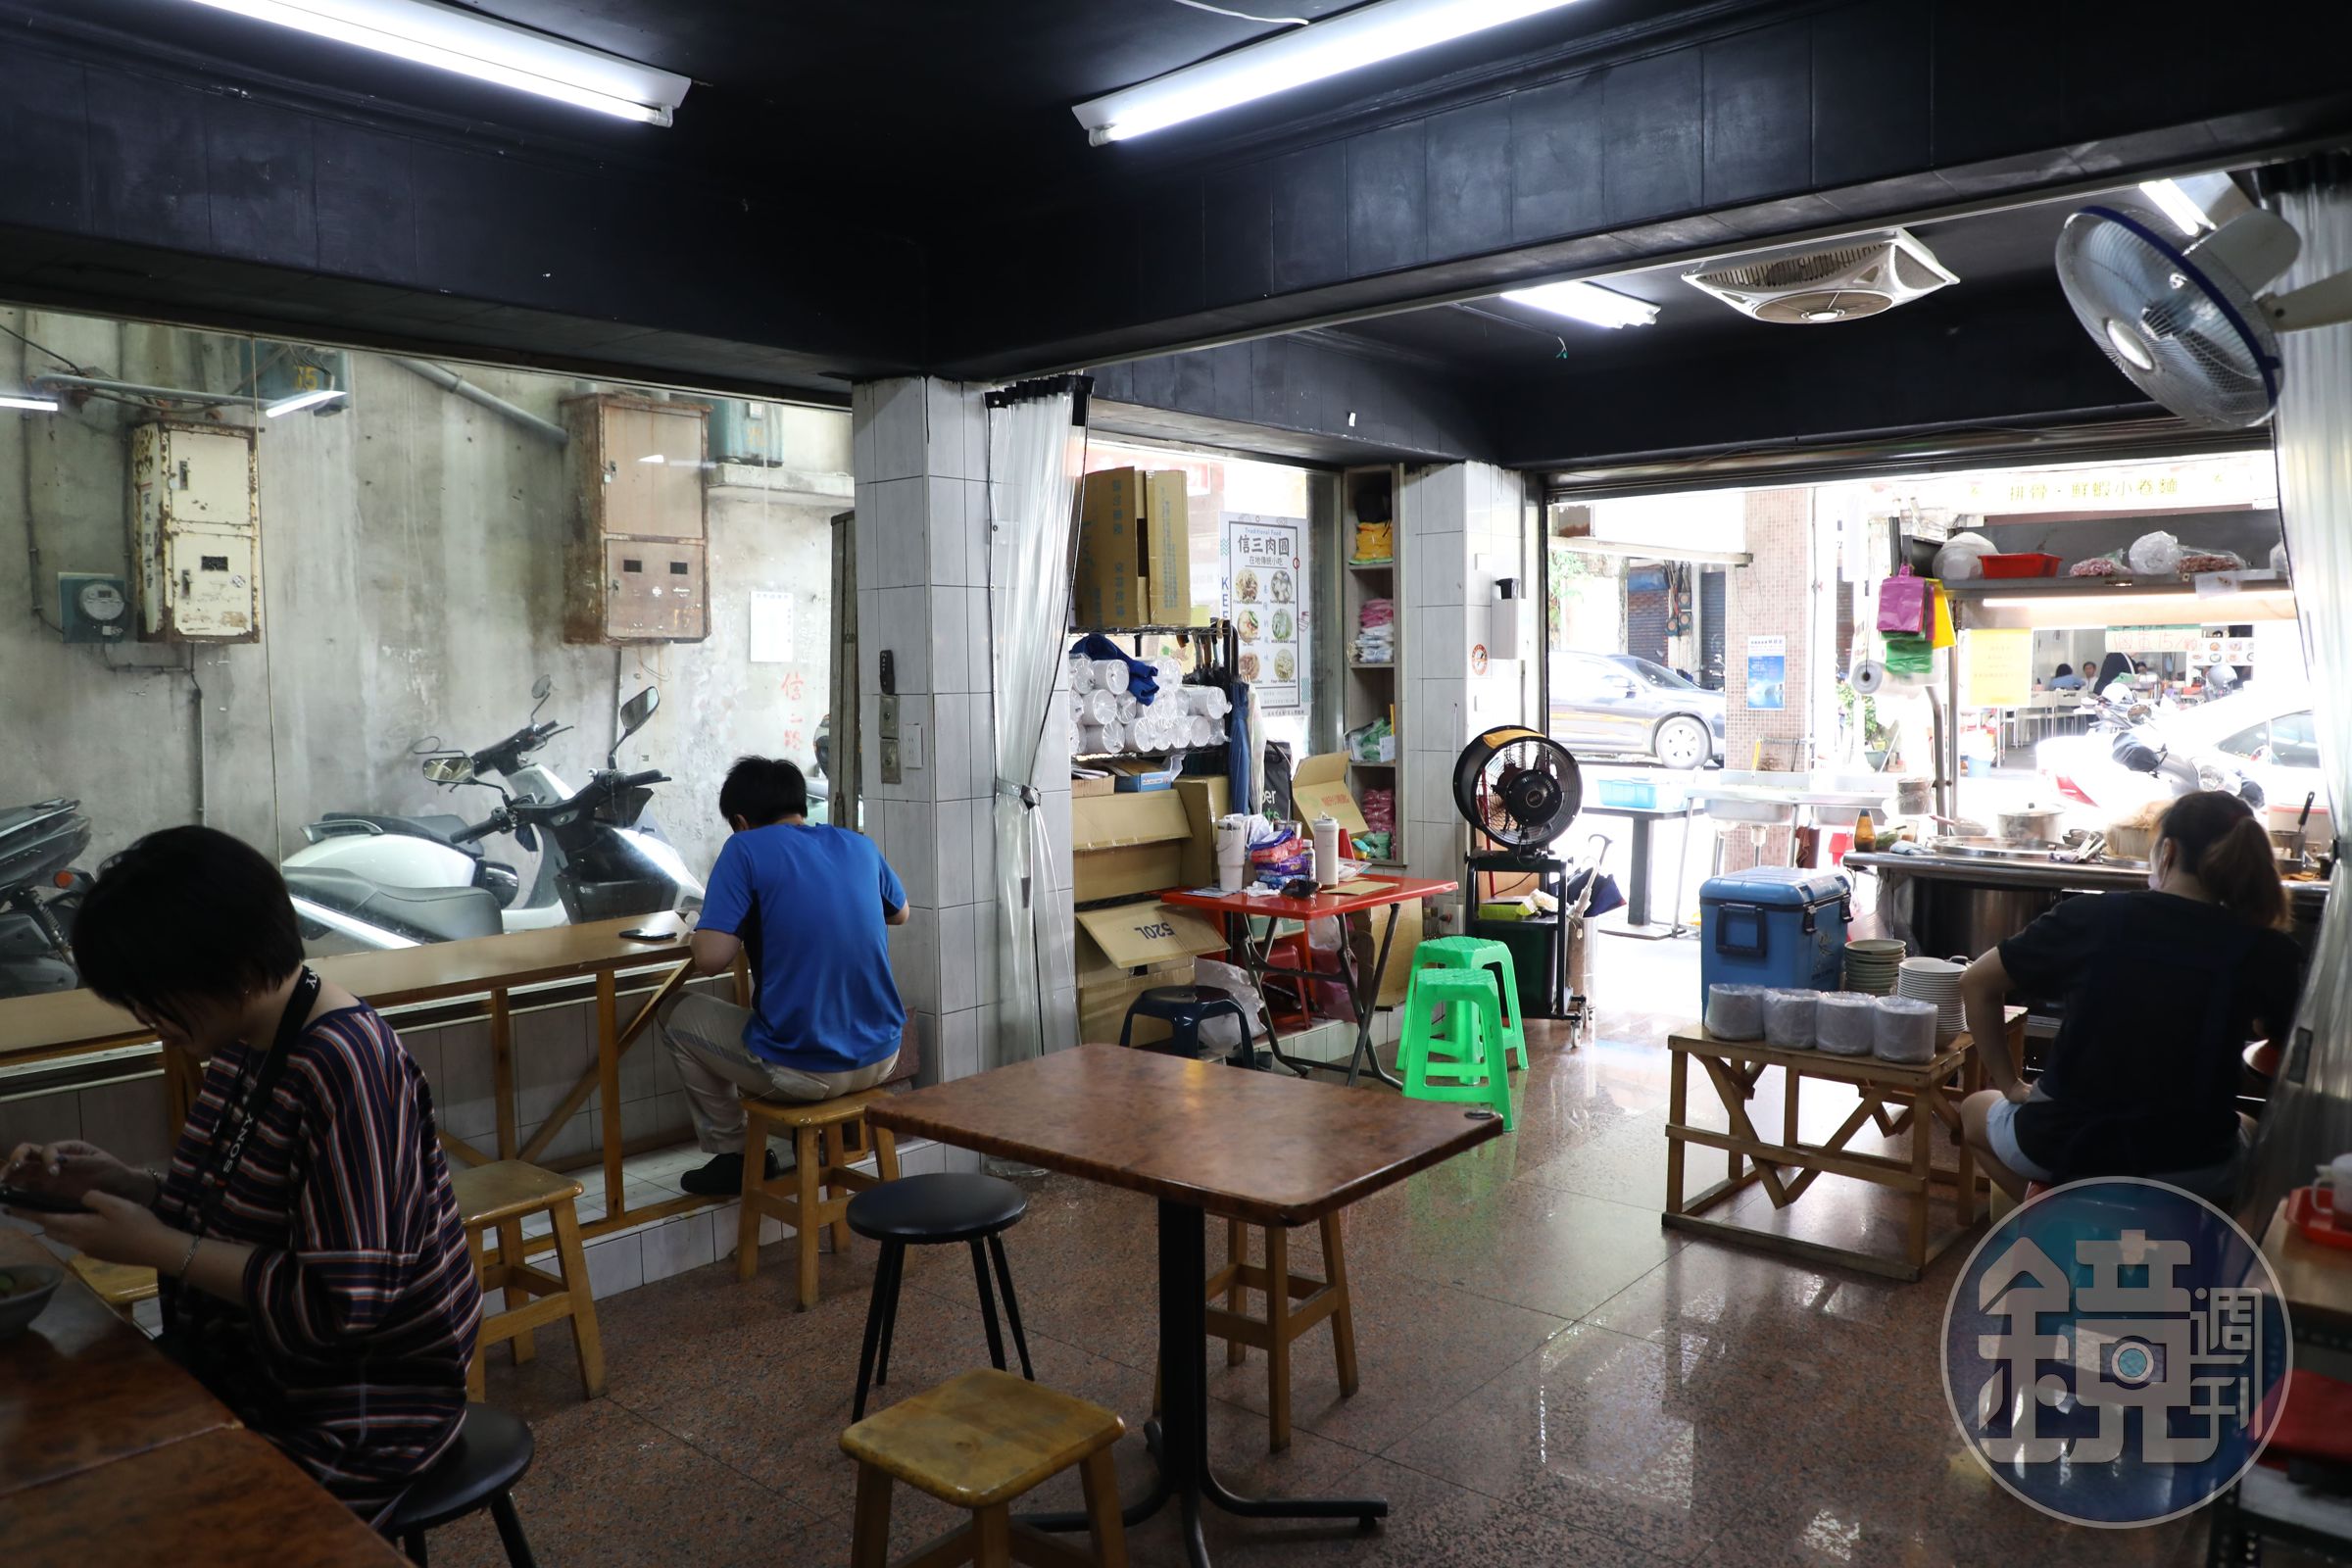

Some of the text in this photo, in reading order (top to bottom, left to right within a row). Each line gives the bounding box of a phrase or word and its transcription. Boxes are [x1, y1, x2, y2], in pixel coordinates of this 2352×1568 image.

[1238, 534, 1290, 557] 信三肉圓
[1250, 556, 1283, 565] 在地傳統小吃
[1134, 922, 1175, 940] 520L
[222, 1112, 254, 1173] SONY
